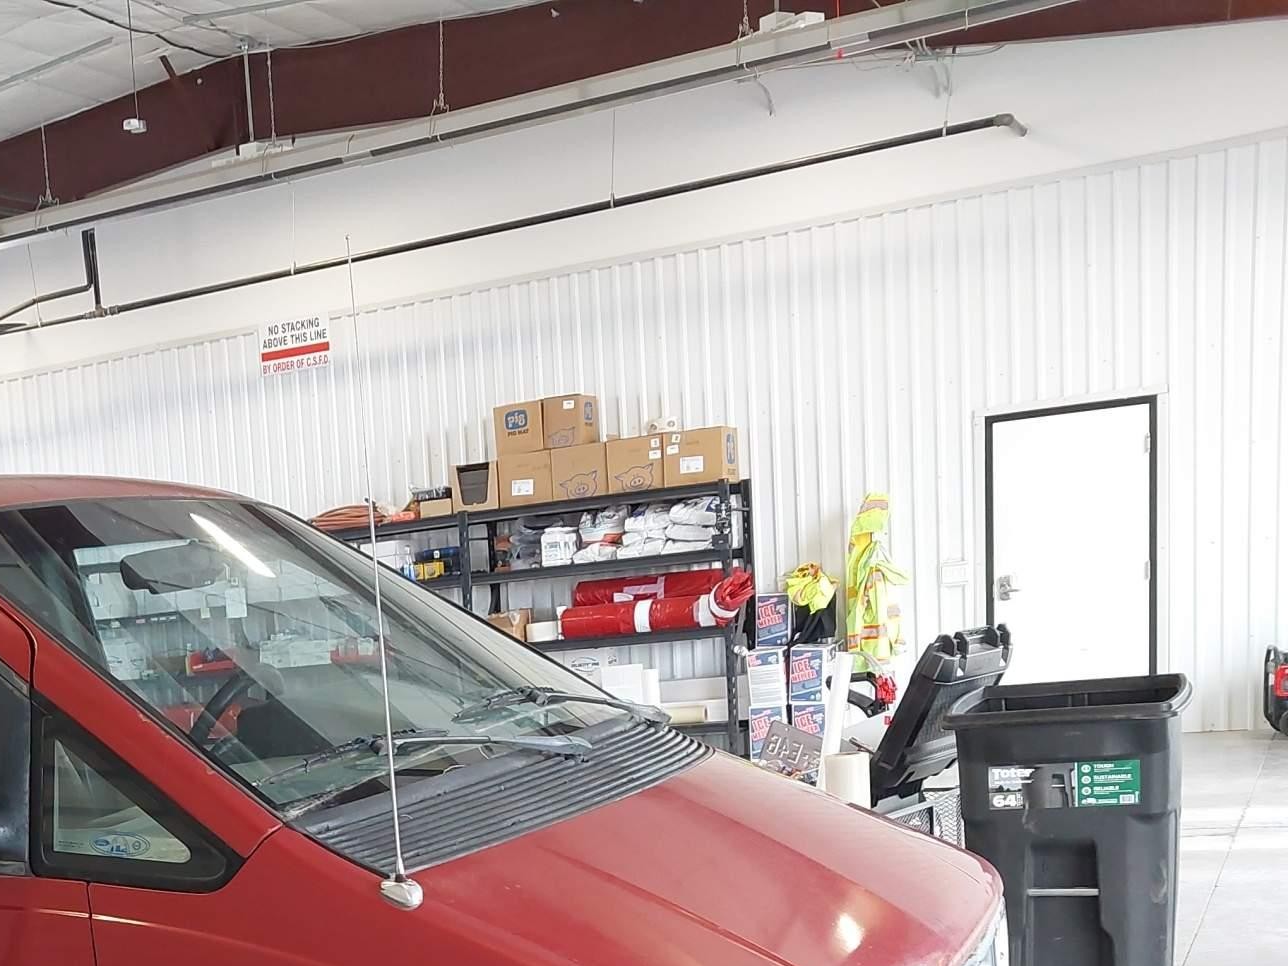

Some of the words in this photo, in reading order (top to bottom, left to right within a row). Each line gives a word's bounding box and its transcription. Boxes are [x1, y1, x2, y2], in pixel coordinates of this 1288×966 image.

[268, 324, 279, 336] NO
[281, 317, 320, 334] STACKING
[263, 335, 288, 350] ABOVE
[291, 332, 308, 345] THIS
[310, 328, 328, 341] LINE
[263, 364, 271, 374] BY
[273, 360, 295, 373] ORDER
[297, 358, 305, 369] OF
[507, 411, 526, 428] pig
[792, 659, 811, 676] ICE
[992, 794, 1017, 808] 64
